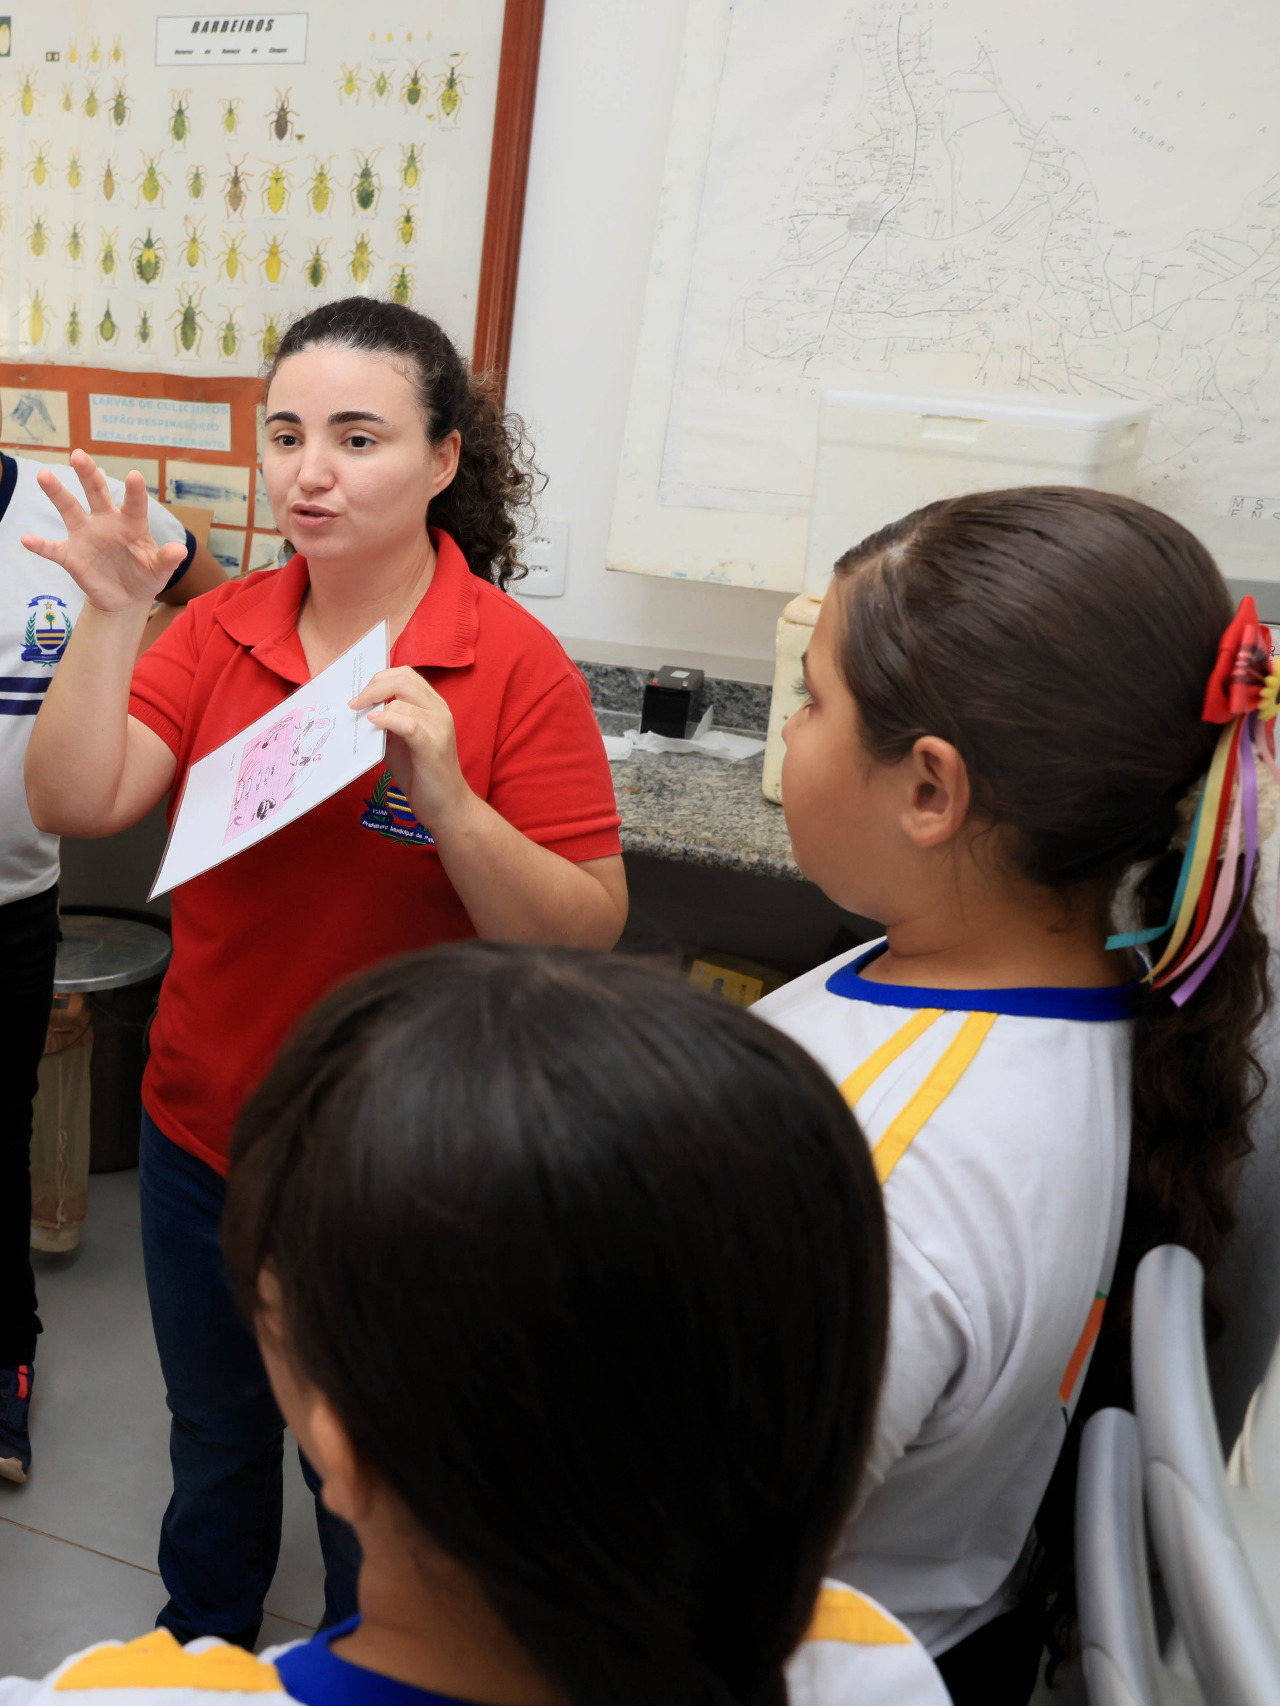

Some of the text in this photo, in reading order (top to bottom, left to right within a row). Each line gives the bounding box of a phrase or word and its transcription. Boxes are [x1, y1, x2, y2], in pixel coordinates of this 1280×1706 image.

[190, 18, 275, 35] BARBEIROS
[92, 396, 135, 409] LARVAS
[138, 399, 154, 410] DE
[102, 413, 135, 425] SIFÃO
[141, 434, 156, 443] DO
